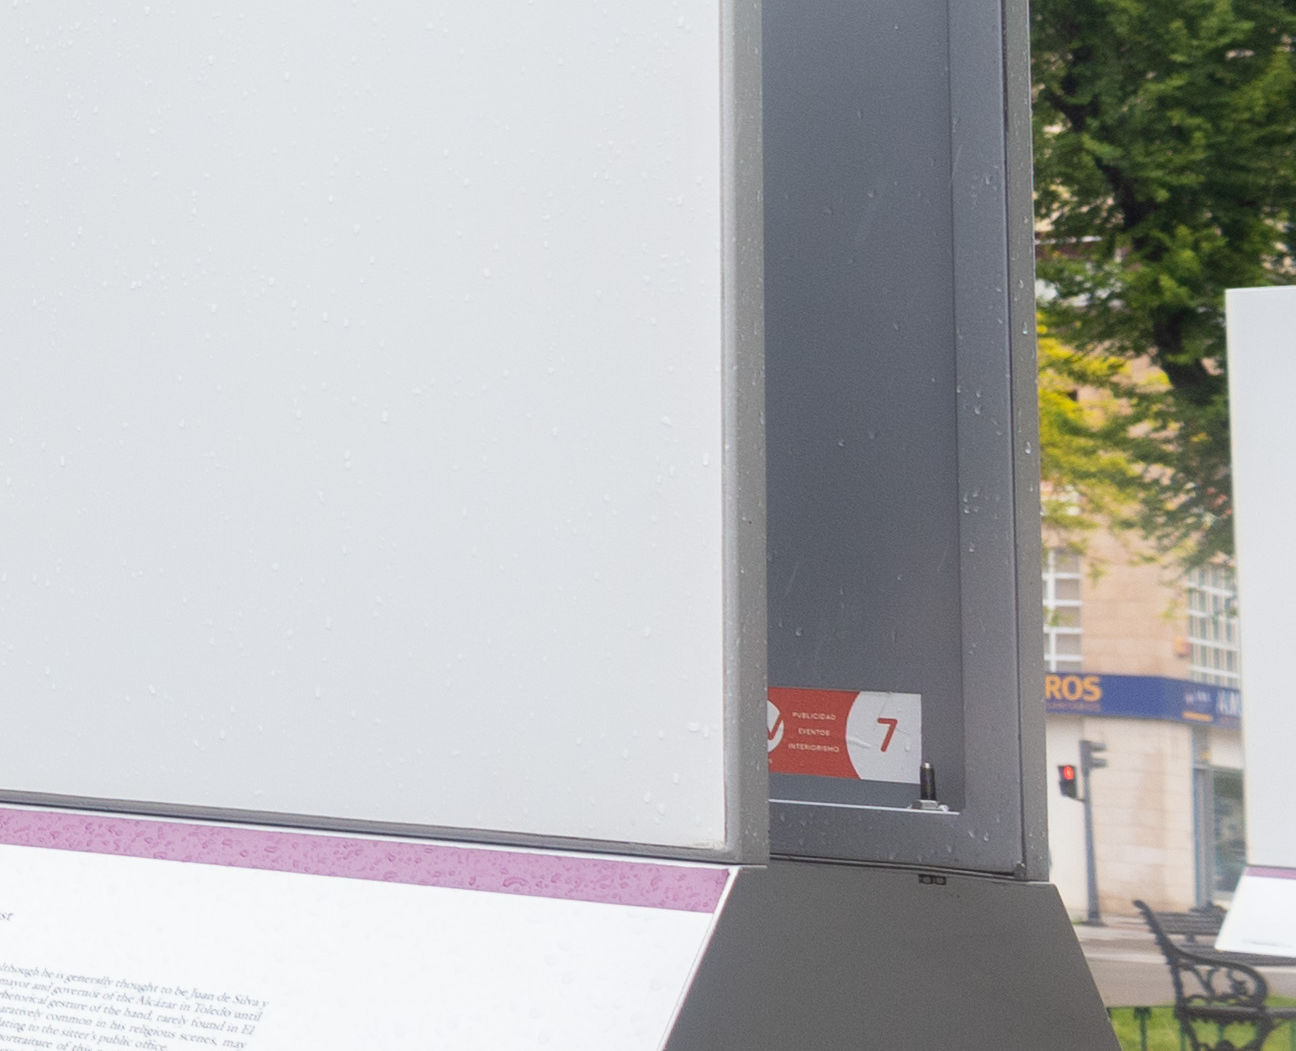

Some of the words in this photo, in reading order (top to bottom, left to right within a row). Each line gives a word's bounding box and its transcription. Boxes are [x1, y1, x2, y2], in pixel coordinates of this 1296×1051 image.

[792, 712, 836, 721] PUBLICIDAD
[798, 728, 830, 737] EVENTOS
[788, 743, 840, 753] INTERIORISMO
[877, 717, 898, 753] 7
[31, 982, 53, 992] and
[50, 986, 100, 998] governor
[178, 1003, 191, 1011] in
[194, 1002, 231, 1017] Toledo
[233, 1011, 263, 1021] until
[40, 967, 54, 979] he
[63, 974, 113, 987] generally
[115, 978, 158, 993] thought
[159, 986, 172, 994] to
[173, 986, 188, 997] be
[185, 987, 214, 1000] Juan
[216, 991, 231, 1003] de
[231, 994, 259, 1006] Silva
[45, 1013, 92, 1025] common
[109, 1020, 125, 1031] his
[128, 1024, 175, 1038] religious
[221, 1039, 247, 1051] may
[46, 999, 87, 1010] gesture
[156, 1014, 188, 1027] rarely
[190, 1017, 226, 1031] found
[225, 1022, 238, 1033] in
[27, 1023, 40, 1032] to
[60, 1029, 97, 1041] sitter's
[96, 1034, 133, 1046] public
